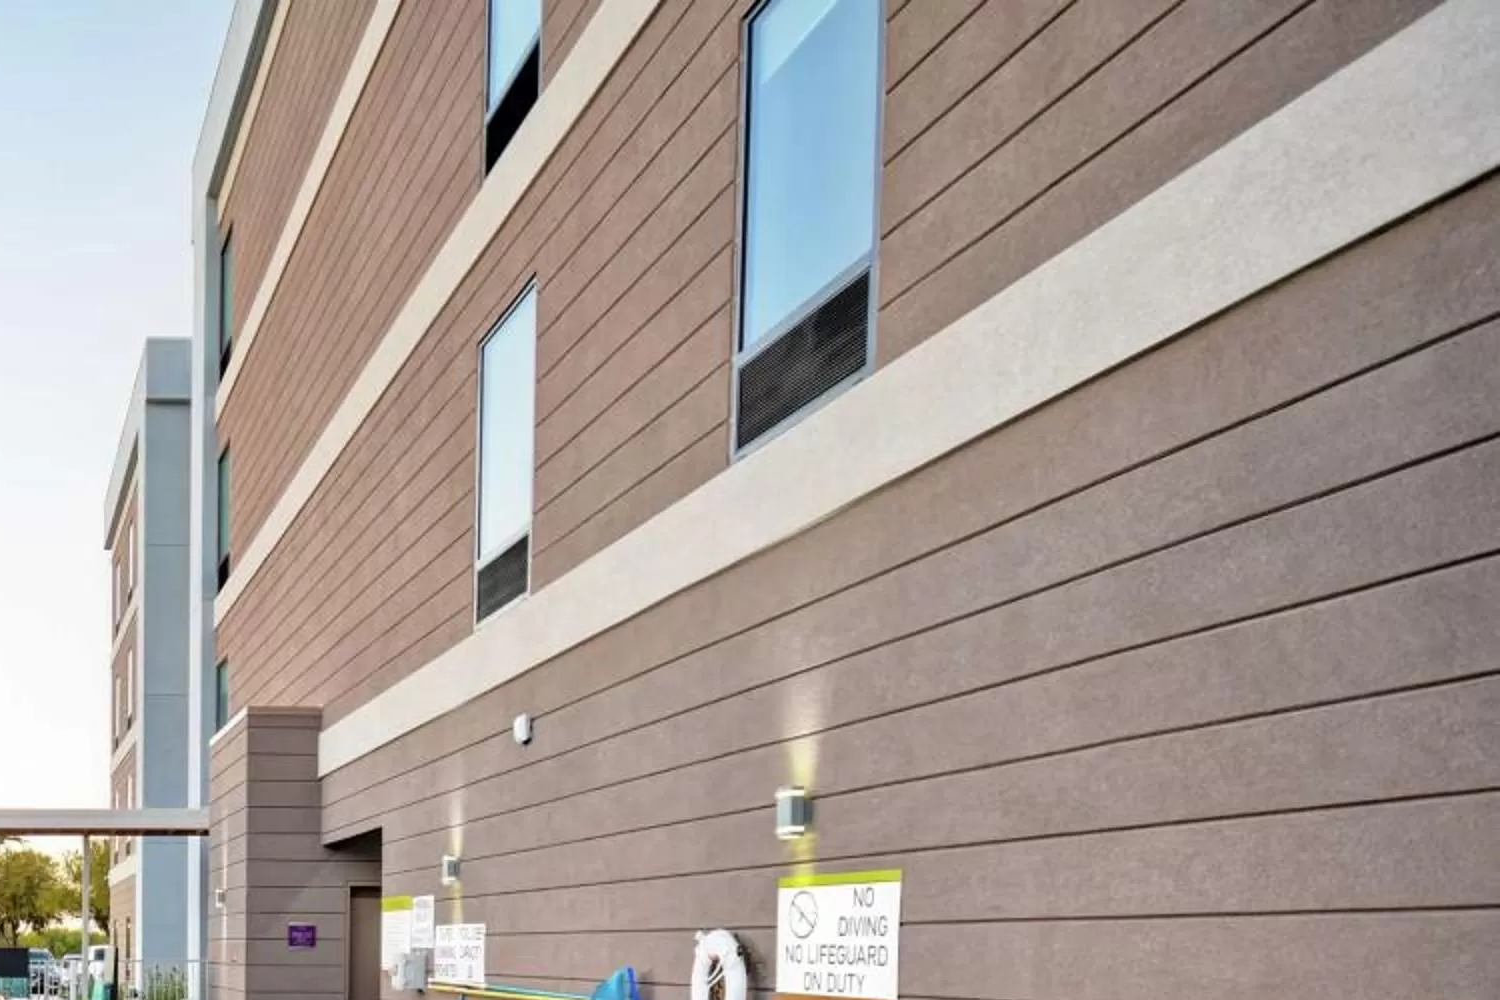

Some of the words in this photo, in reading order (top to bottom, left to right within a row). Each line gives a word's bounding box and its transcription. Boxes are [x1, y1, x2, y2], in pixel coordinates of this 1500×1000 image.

[853, 886, 875, 908] NO
[837, 915, 888, 937] DIVING
[785, 943, 803, 964] NO
[807, 944, 889, 967] LIFEGUARD
[803, 971, 822, 992] ON
[826, 972, 865, 993] DUTY
